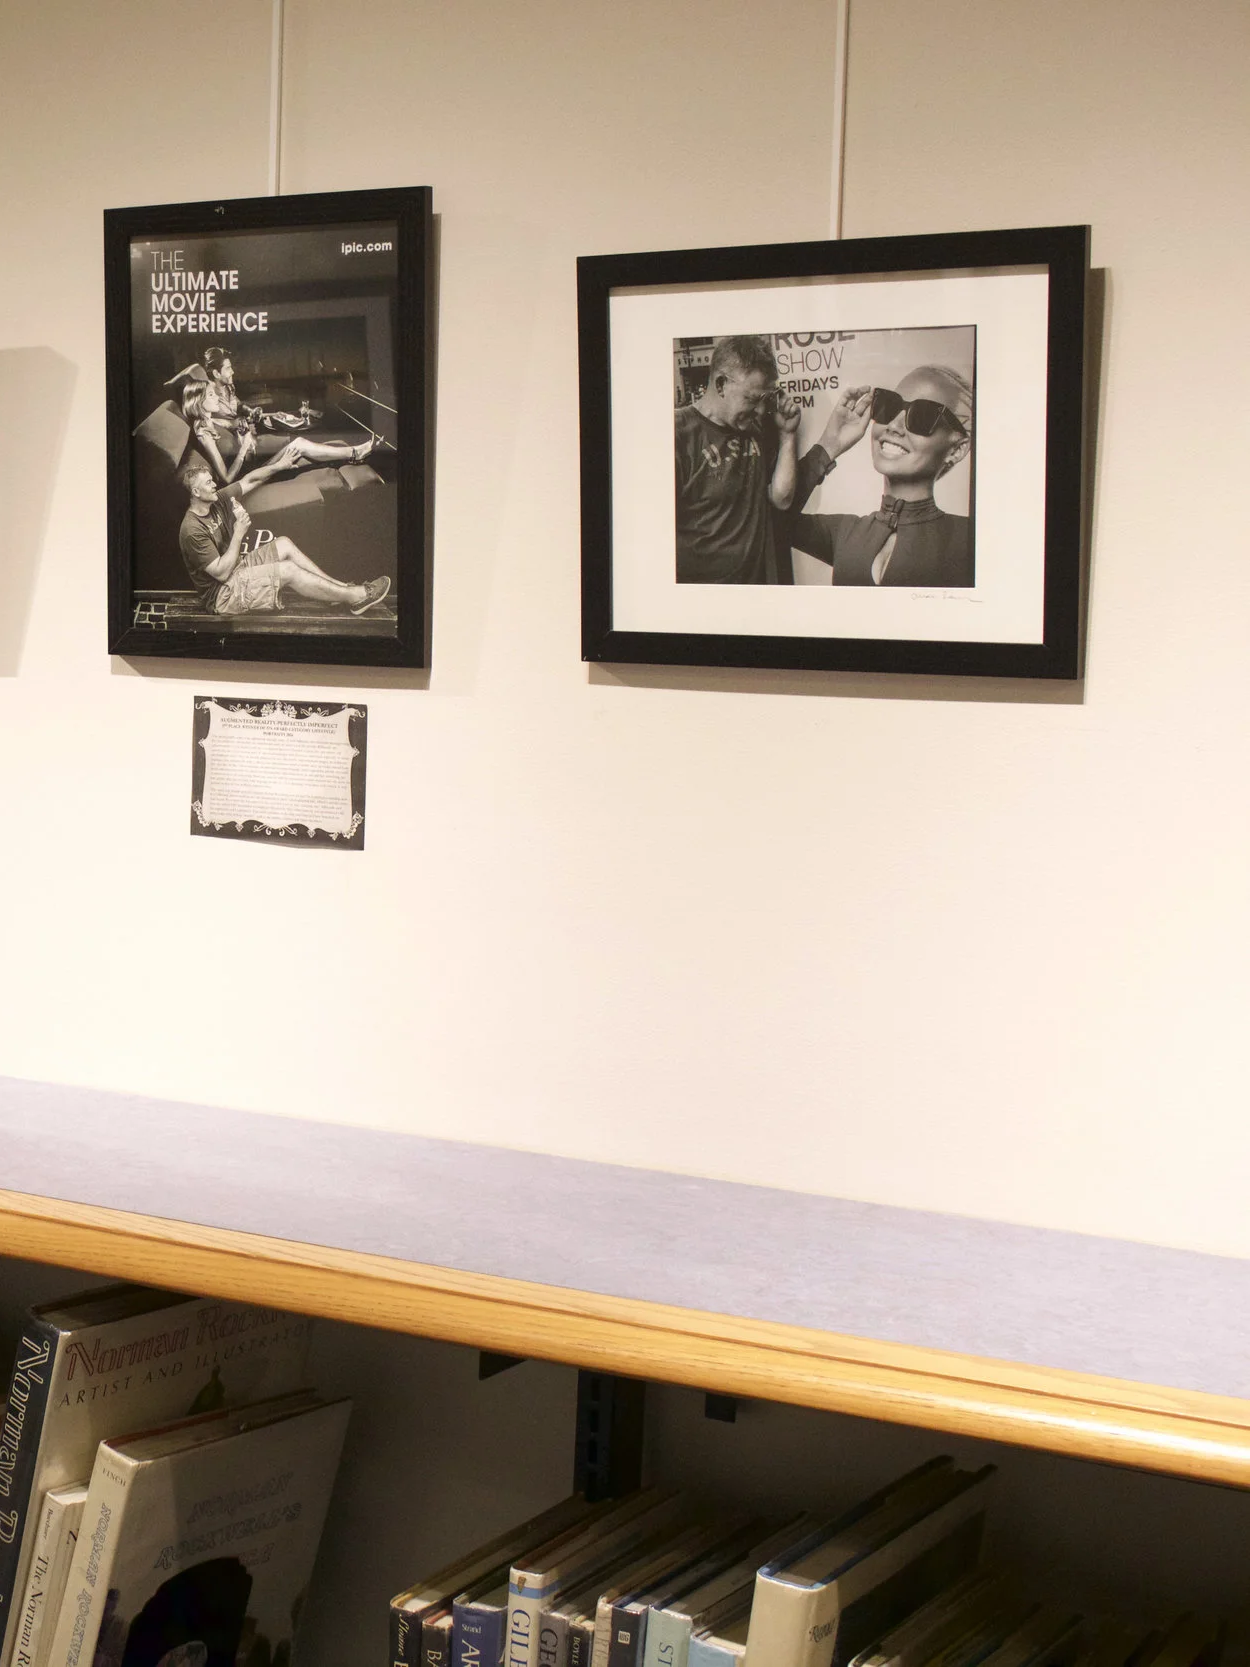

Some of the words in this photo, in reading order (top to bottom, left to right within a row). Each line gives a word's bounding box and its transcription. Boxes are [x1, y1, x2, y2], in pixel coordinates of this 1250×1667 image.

[341, 241, 393, 255] ipic.com
[151, 250, 184, 271] THE
[151, 270, 239, 292] ULTIMATE
[151, 292, 216, 313] MOVIE
[151, 312, 268, 334] EXPERIENCE
[777, 346, 845, 375] SHOW
[779, 376, 839, 394] FRIDAYS
[59, 1377, 131, 1408] ARTIST
[143, 1362, 183, 1385] AND
[36, 1554, 51, 1585] The
[22, 1588, 44, 1647] Norman
[461, 1623, 482, 1634] Strand
[571, 1636, 581, 1665] BOYLE
